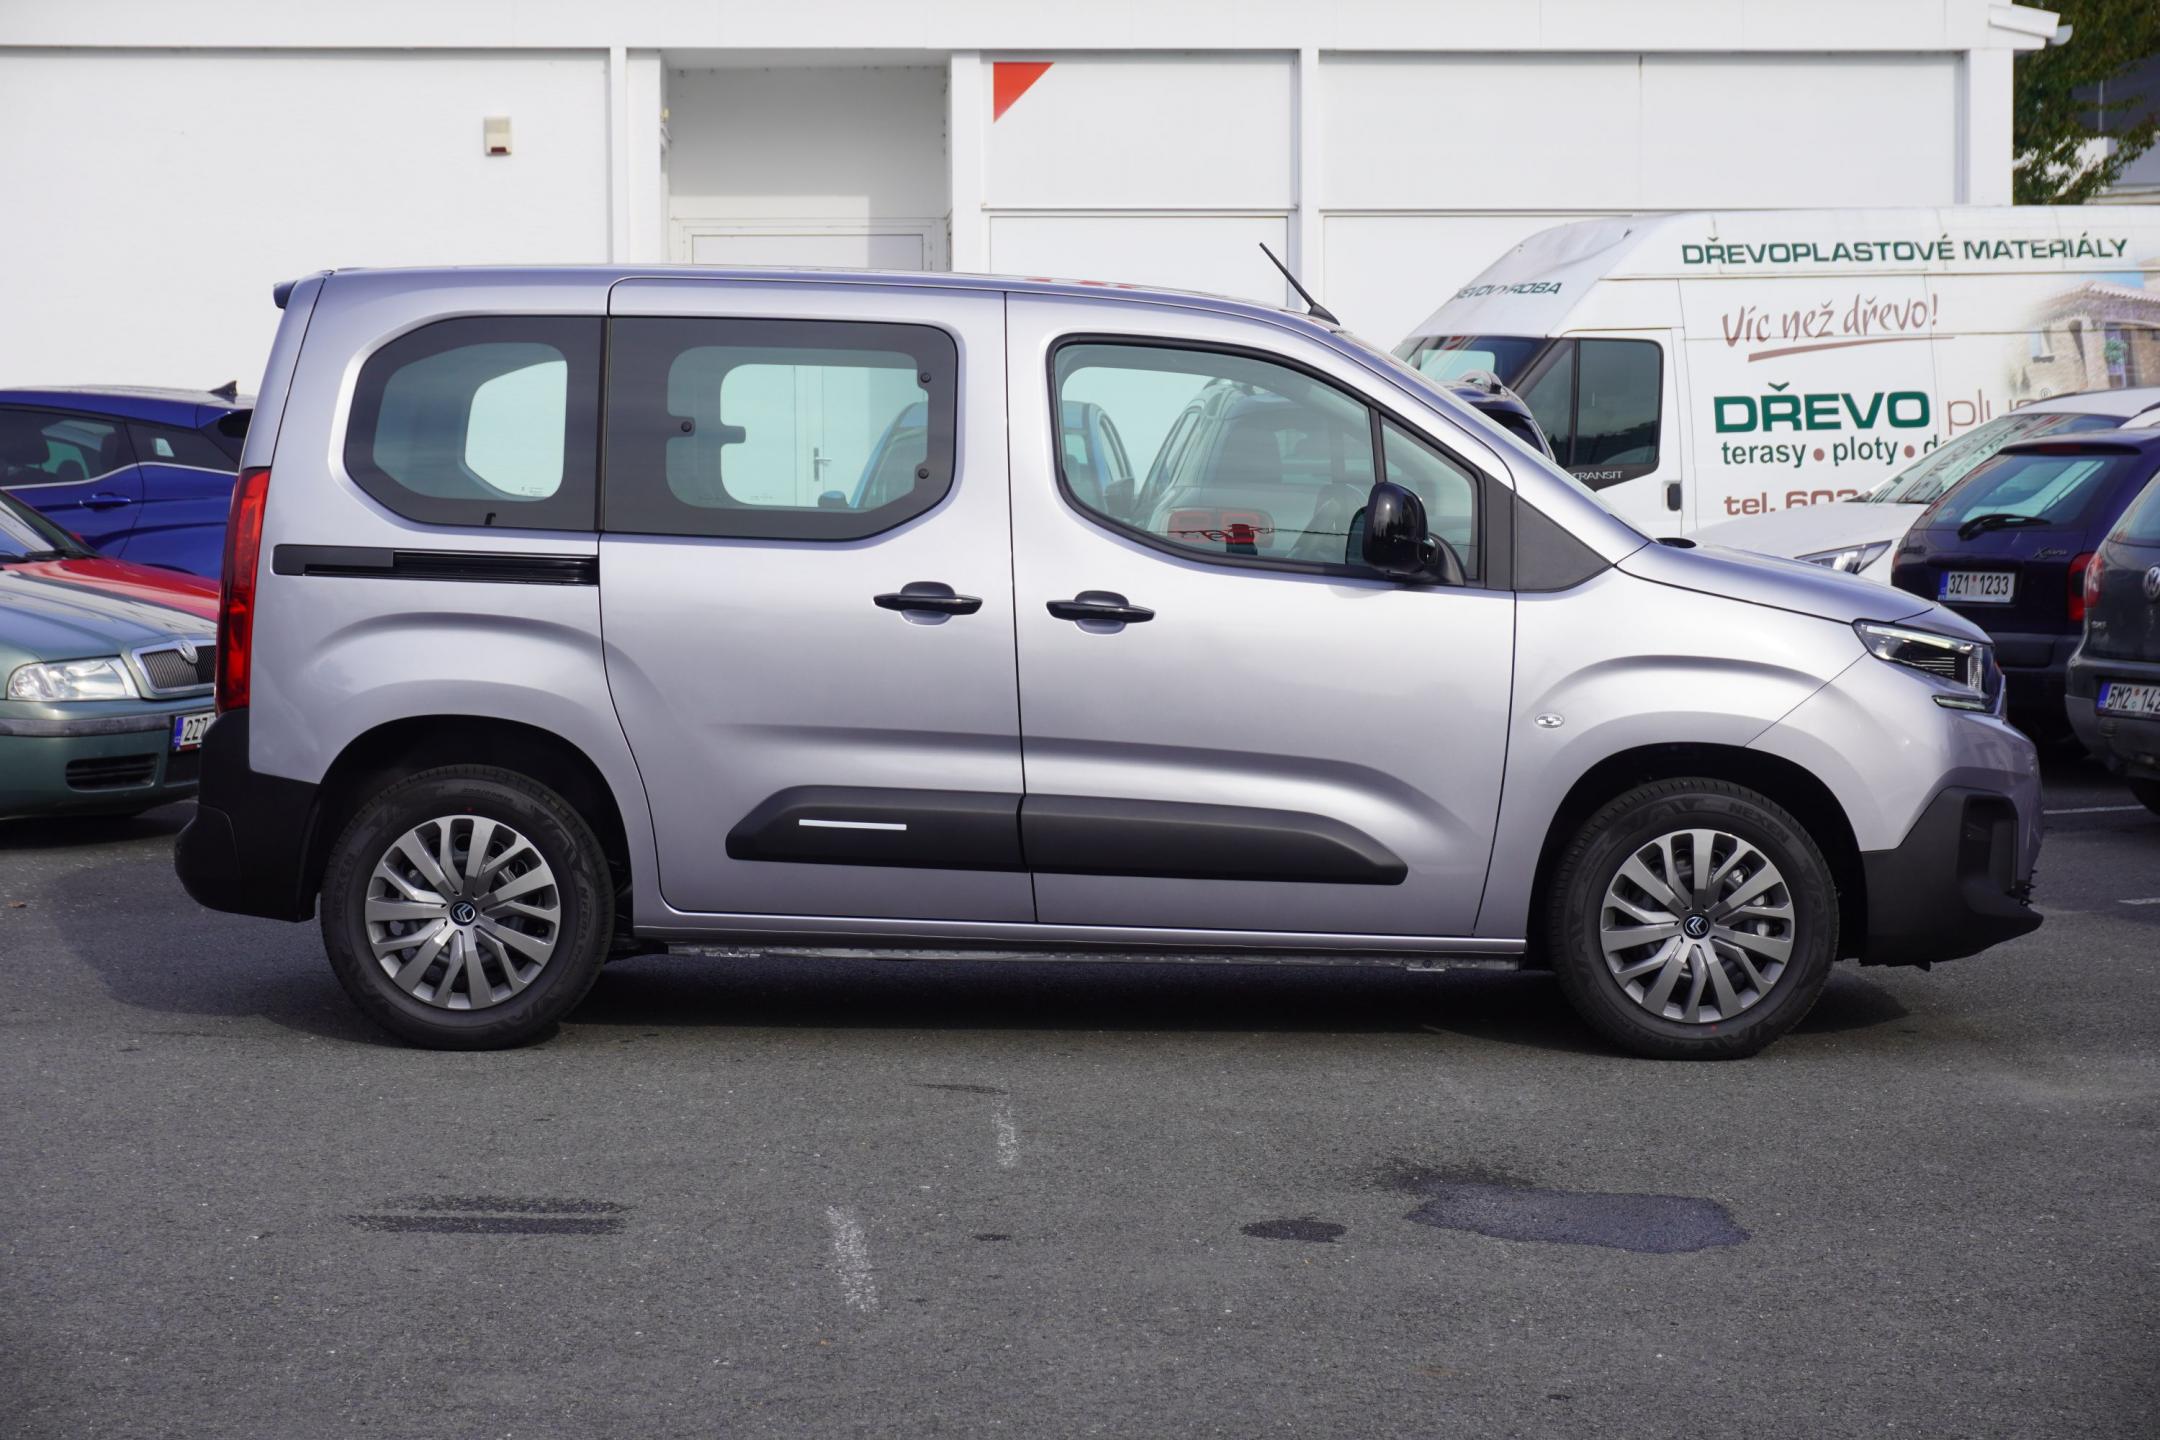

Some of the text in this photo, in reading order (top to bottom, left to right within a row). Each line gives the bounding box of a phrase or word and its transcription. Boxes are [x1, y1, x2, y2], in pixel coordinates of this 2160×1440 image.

[1681, 231, 2128, 265] DŘEVOPLASTOVÉ MATERIÁLY
[1721, 293, 1938, 348] Víc než dřevo!
[1713, 382, 2038, 436] DŘEVO pl
[1721, 441, 1807, 469] terasy
[1832, 436, 1899, 467] ploty
[1724, 492, 1777, 516] tel.
[1949, 574, 2009, 595] 3Z1 1233
[2107, 686, 2132, 709] 5M2
